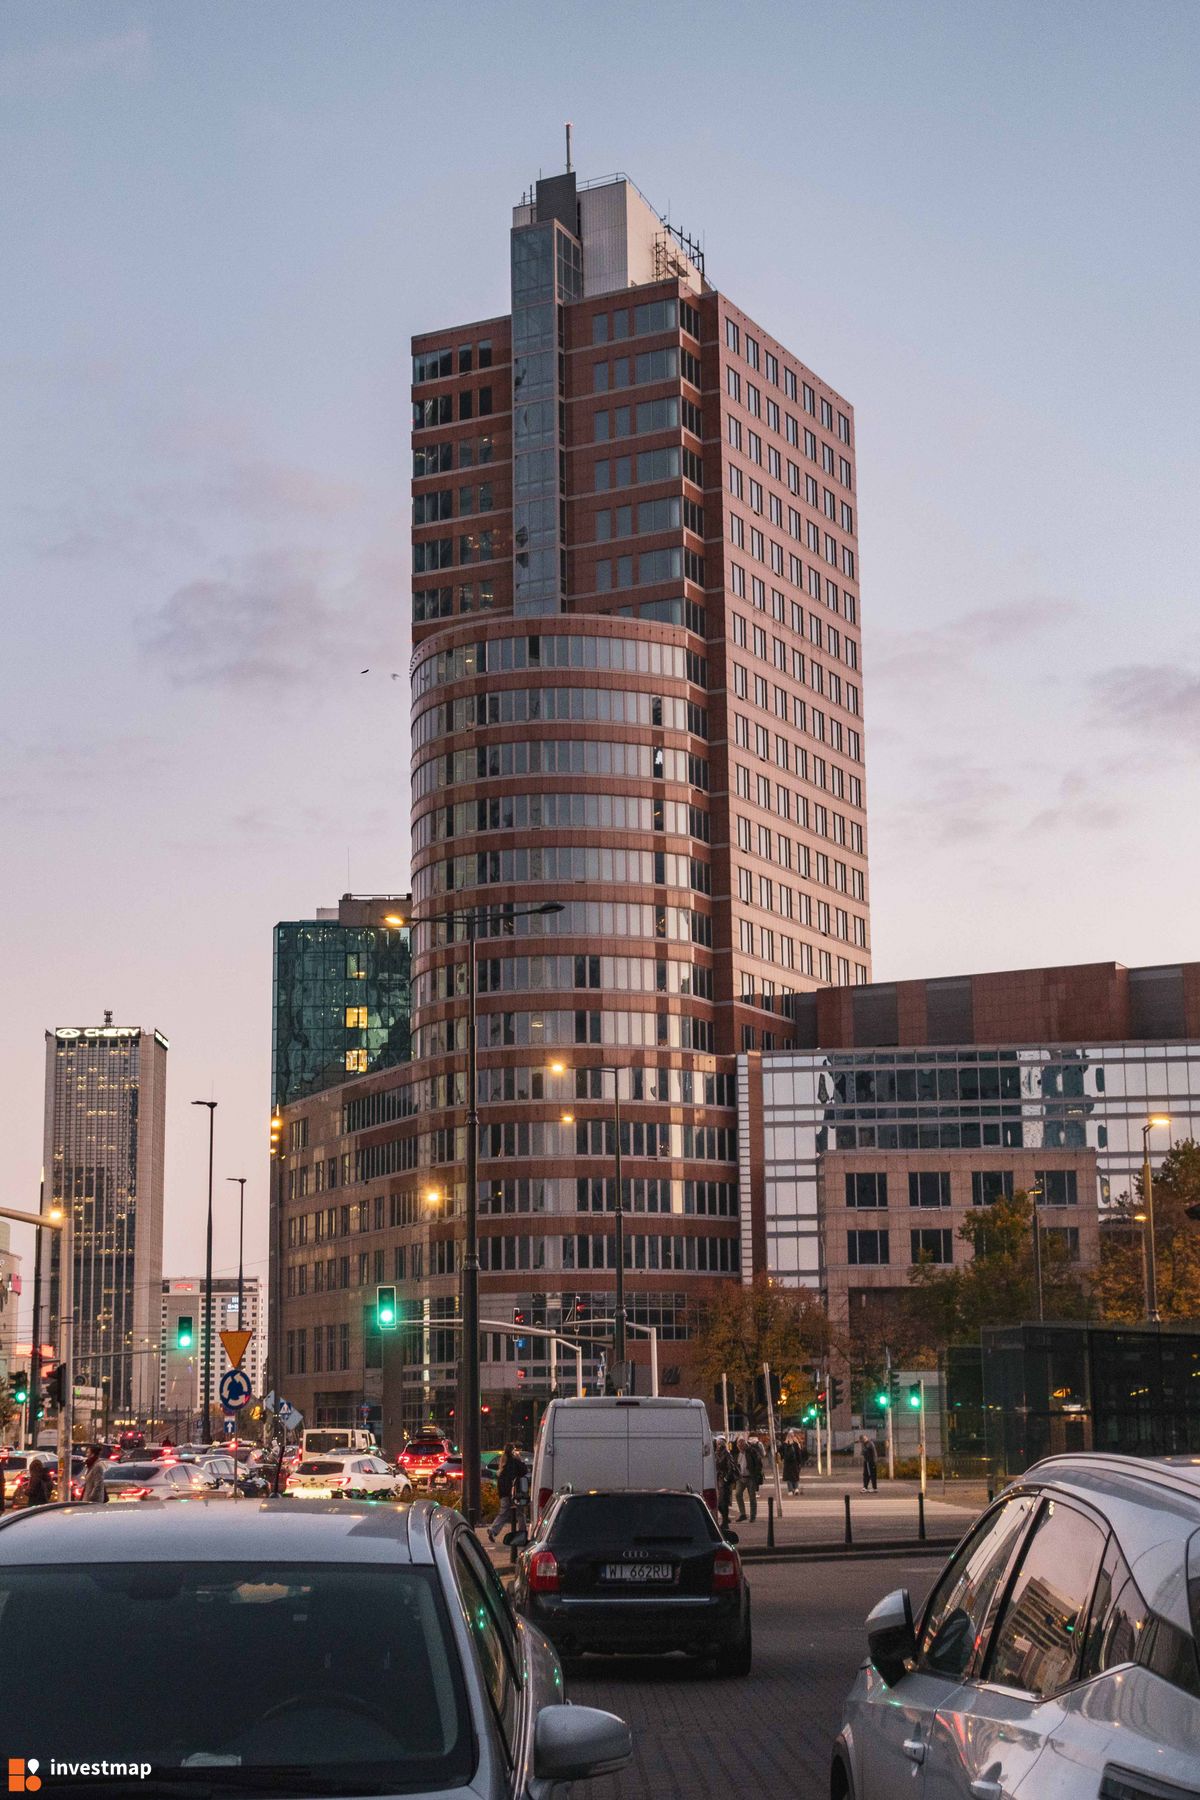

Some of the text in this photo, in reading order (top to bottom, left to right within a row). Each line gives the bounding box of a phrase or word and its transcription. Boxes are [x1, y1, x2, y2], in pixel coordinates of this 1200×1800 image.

[84, 1028, 140, 1037] CHERY
[609, 1565, 669, 1578] WI 662RU
